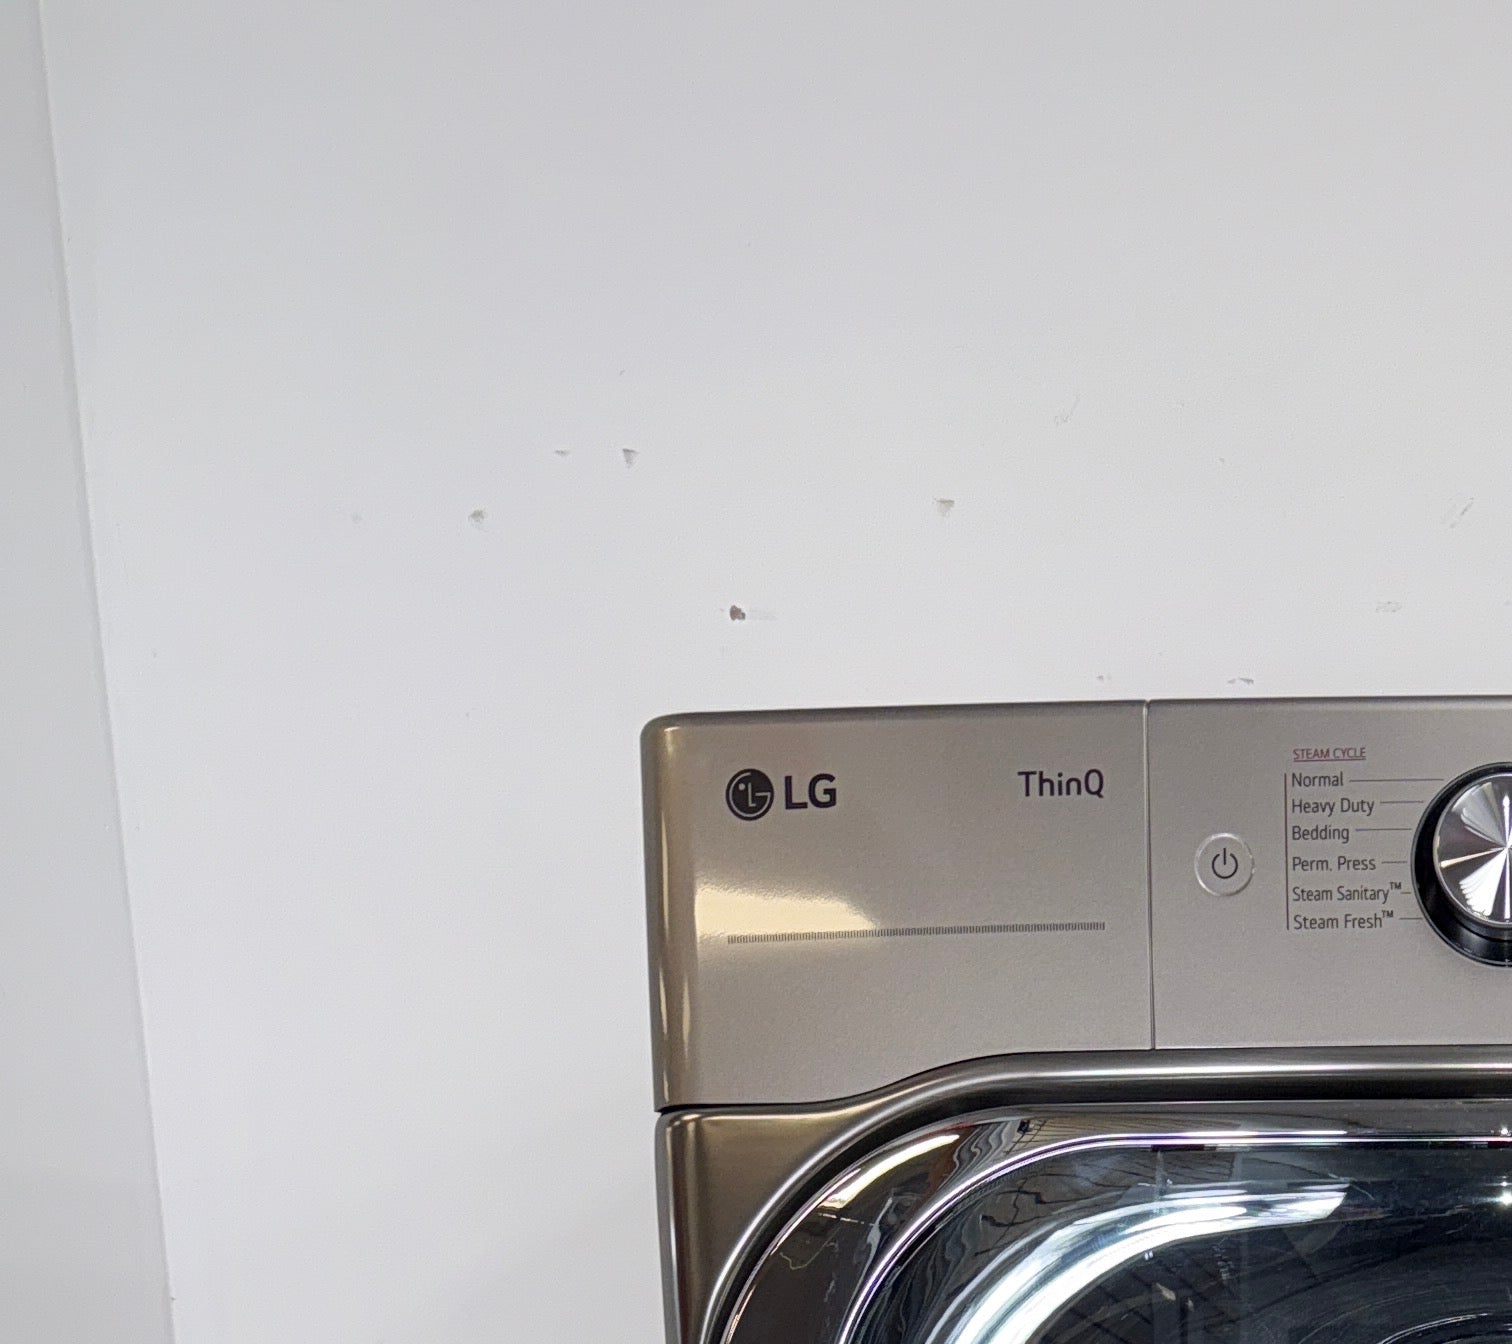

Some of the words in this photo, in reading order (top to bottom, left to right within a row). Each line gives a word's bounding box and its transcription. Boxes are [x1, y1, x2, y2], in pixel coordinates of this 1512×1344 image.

[1293, 748, 1330, 761] STEAM
[1333, 747, 1366, 760] CYCLE
[1018, 768, 1105, 800] ThinQ
[1292, 771, 1343, 787] Normal
[784, 773, 837, 810] LG
[1291, 799, 1335, 817] Heavy
[1340, 798, 1375, 816] Duty
[1291, 825, 1350, 843] Bedding
[1292, 857, 1333, 872] Perm.
[1337, 856, 1376, 871] Press
[1292, 887, 1333, 901] Steam
[1293, 915, 1339, 930] Steam
